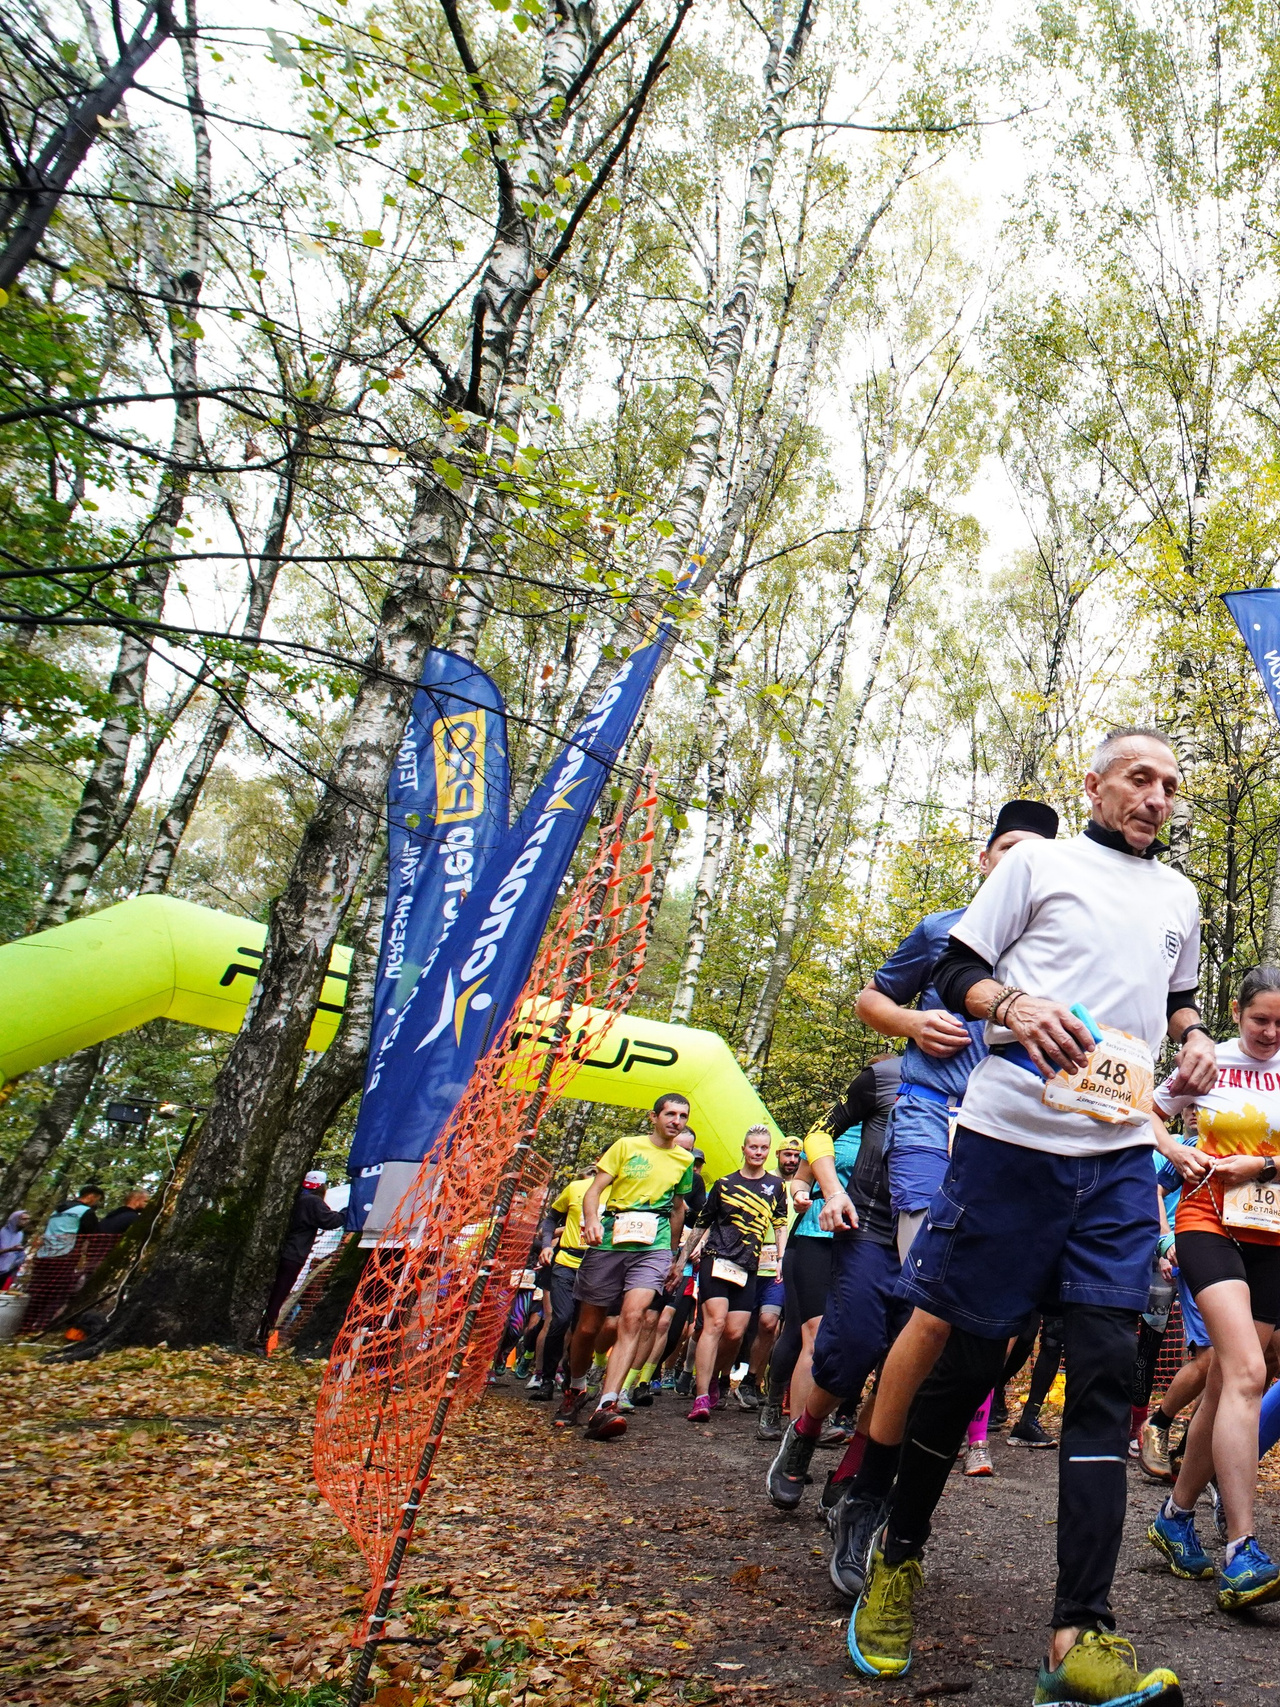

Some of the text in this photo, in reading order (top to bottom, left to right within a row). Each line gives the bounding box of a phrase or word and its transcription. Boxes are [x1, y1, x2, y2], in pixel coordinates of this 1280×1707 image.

[1096, 1059, 1127, 1086] 48
[1080, 1079, 1132, 1103] Валерий
[1254, 1188, 1275, 1205] 10
[630, 1221, 643, 1229] 59
